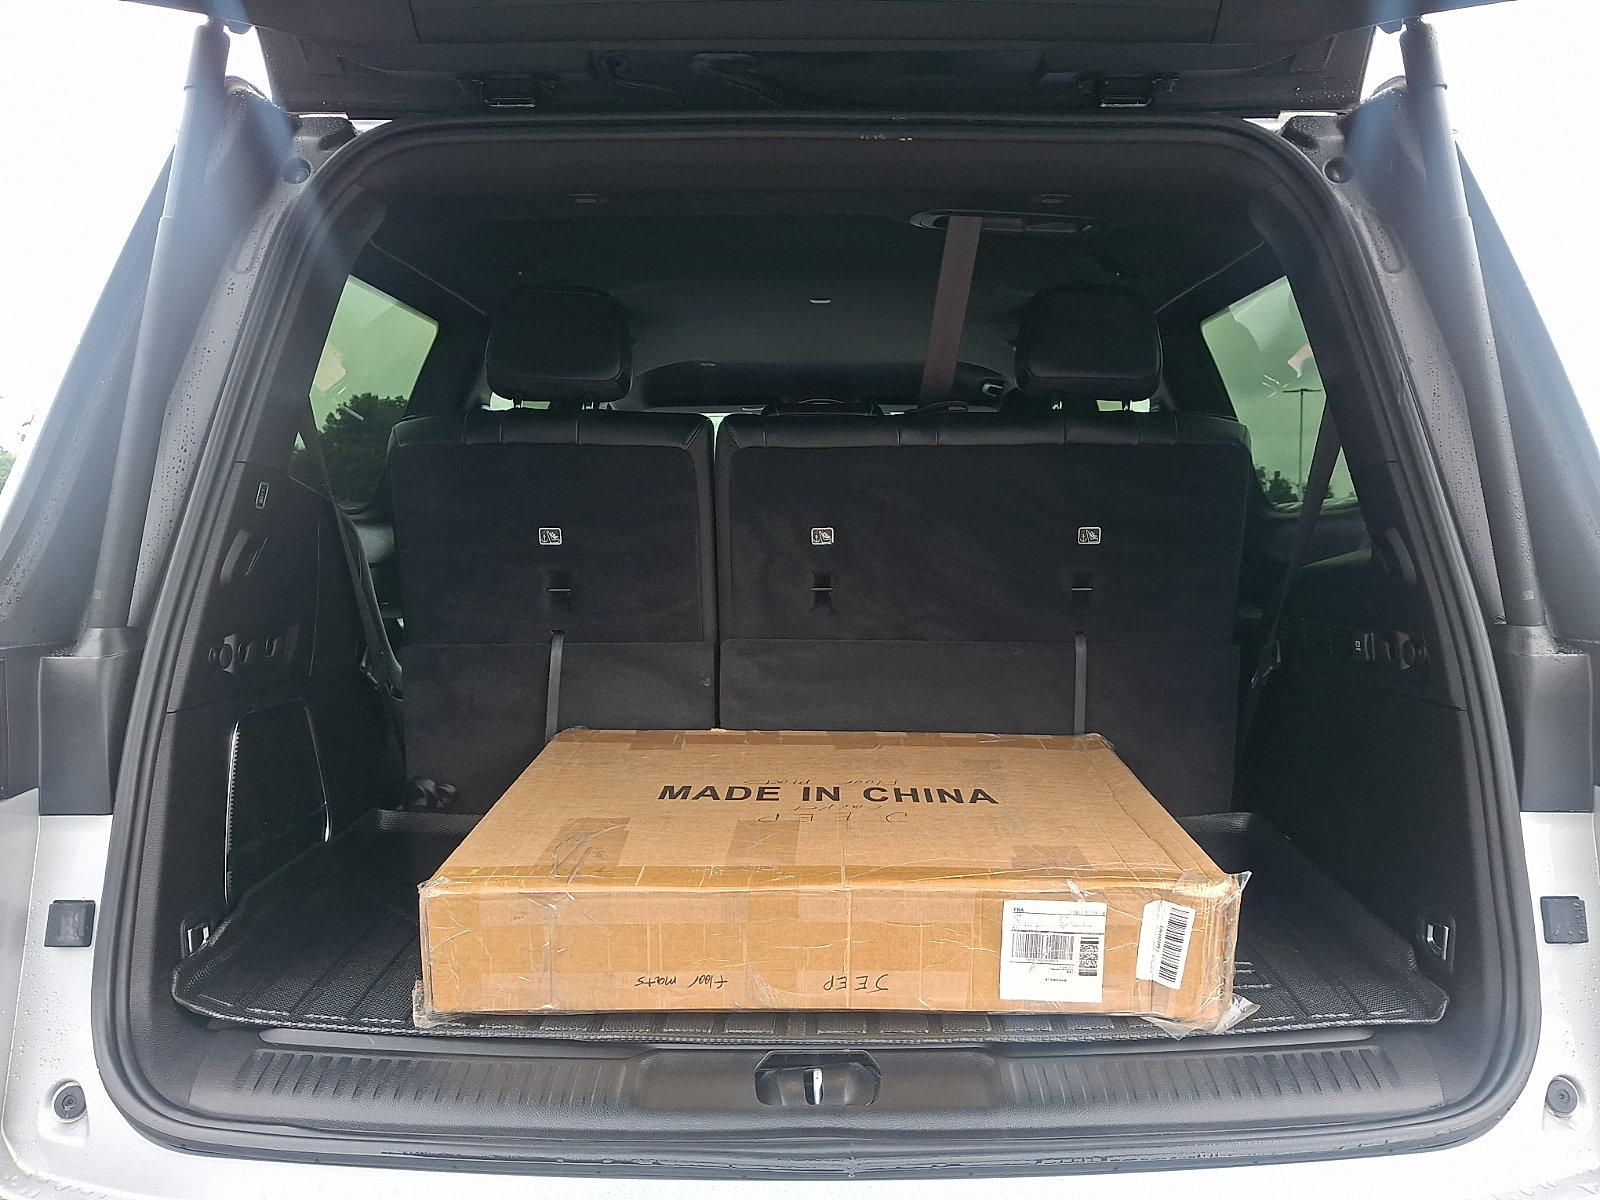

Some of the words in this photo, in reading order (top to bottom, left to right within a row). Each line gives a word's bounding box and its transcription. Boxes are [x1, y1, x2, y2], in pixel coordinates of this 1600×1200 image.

[657, 785, 781, 802] MADE
[802, 786, 841, 802] IN
[863, 786, 1000, 805] CHINA
[757, 811, 909, 824] JEEP
[634, 974, 678, 987] mats
[687, 974, 729, 989] floor
[823, 973, 889, 993] JEEP
